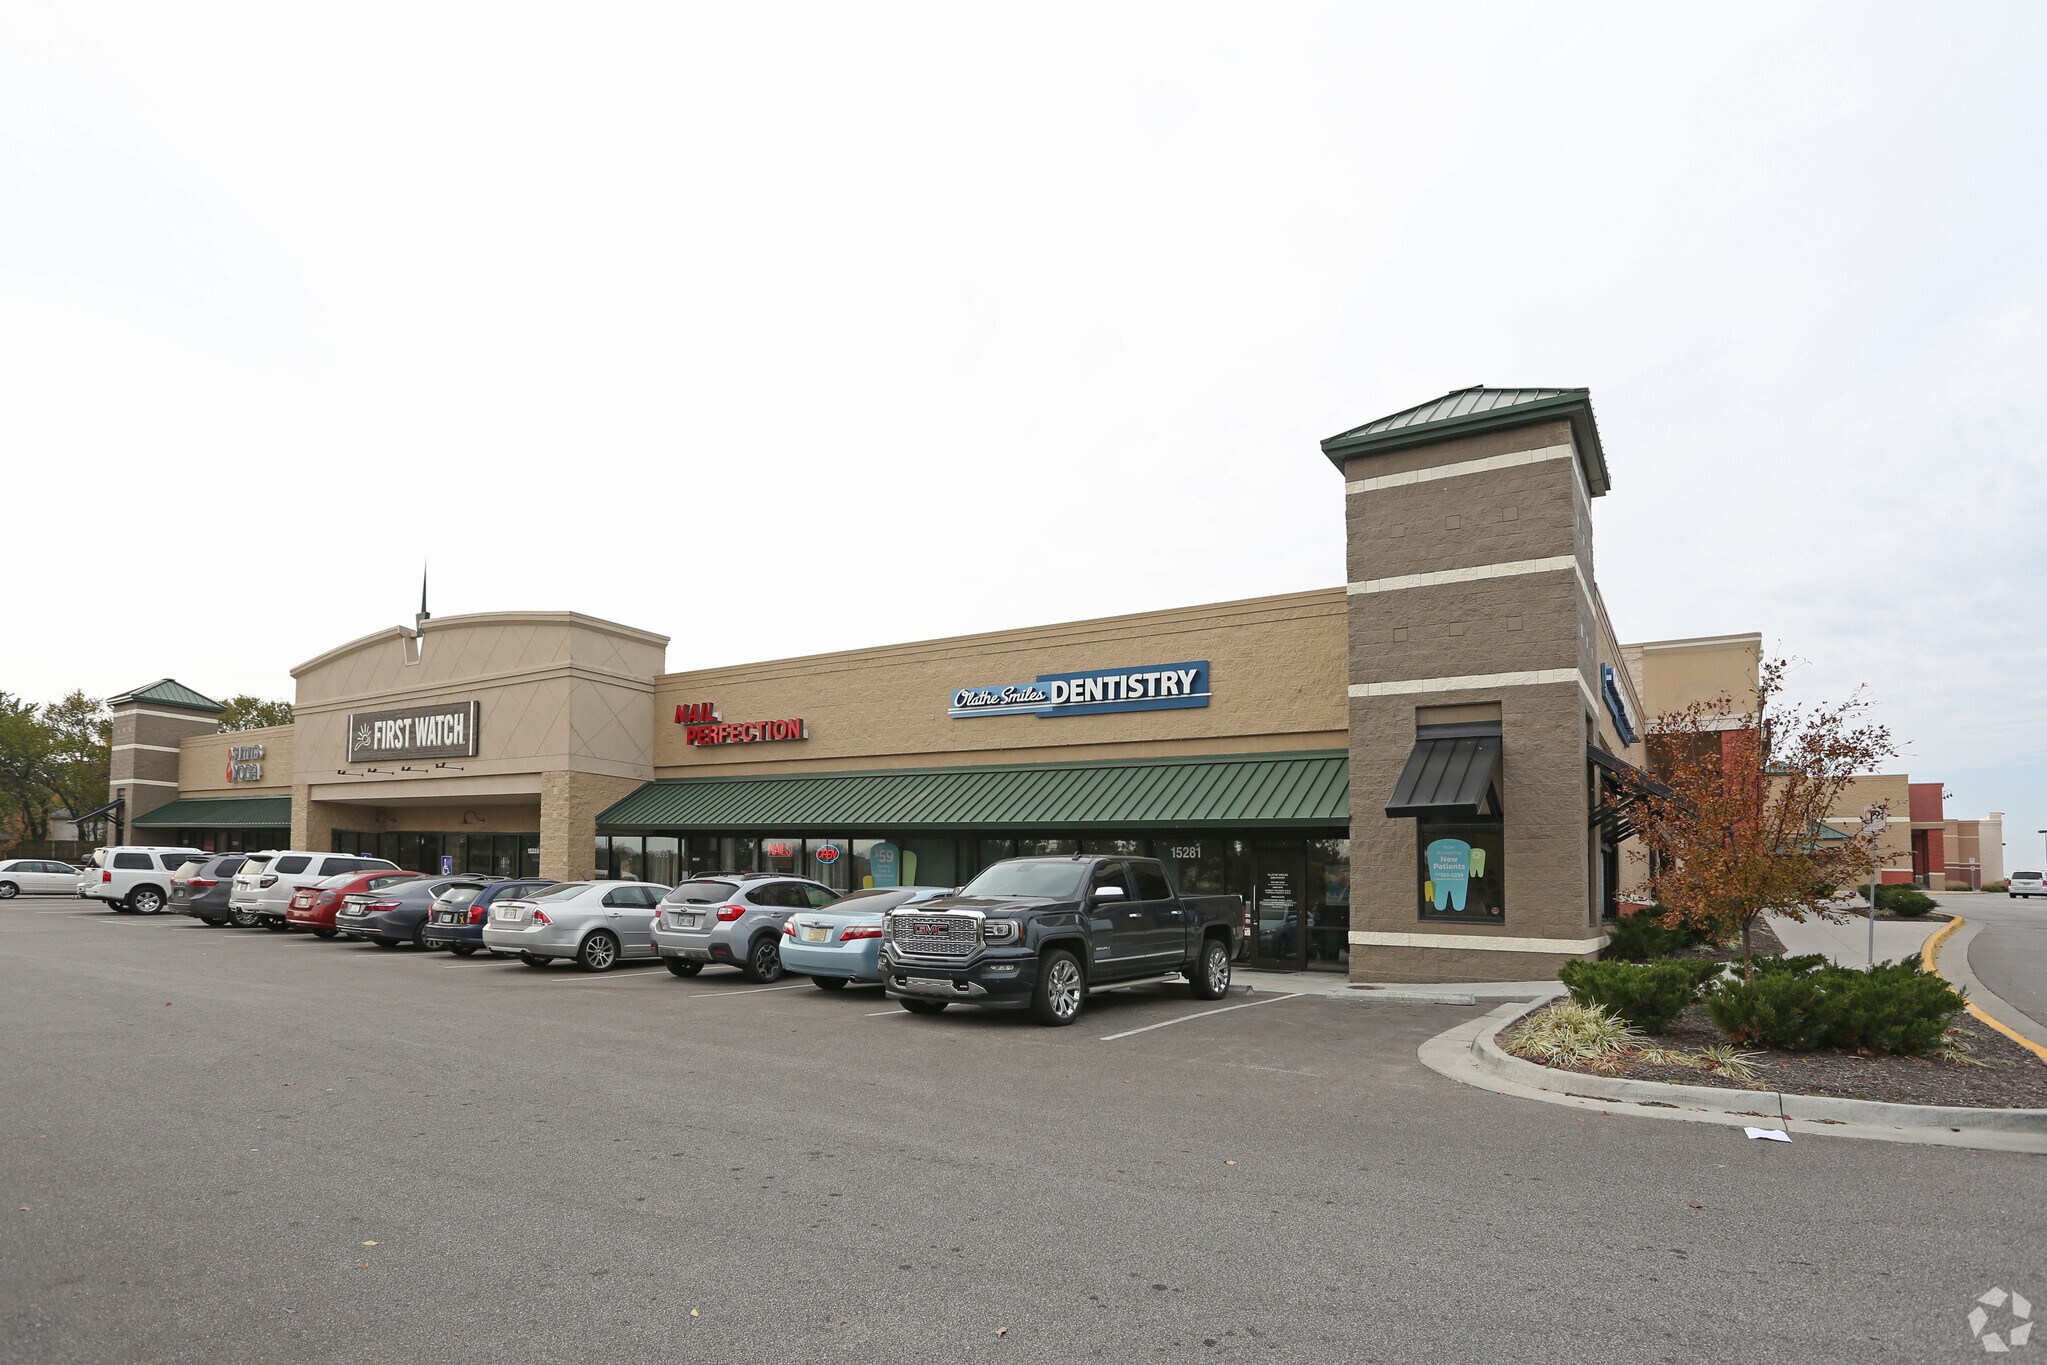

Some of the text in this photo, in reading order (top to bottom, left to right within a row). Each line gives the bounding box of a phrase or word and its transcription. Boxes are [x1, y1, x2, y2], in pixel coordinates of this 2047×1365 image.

[954, 668, 1198, 708] Olathe Smiles DENTISTRY
[674, 702, 717, 724] NAIL
[373, 713, 464, 750] FIRST WATCH
[686, 718, 803, 745] PERFECTION
[233, 764, 260, 781] YOGA
[768, 843, 792, 857] NAILS
[818, 848, 838, 860] OPEN
[1170, 846, 1201, 858] 15281
[913, 923, 948, 935] GMC
